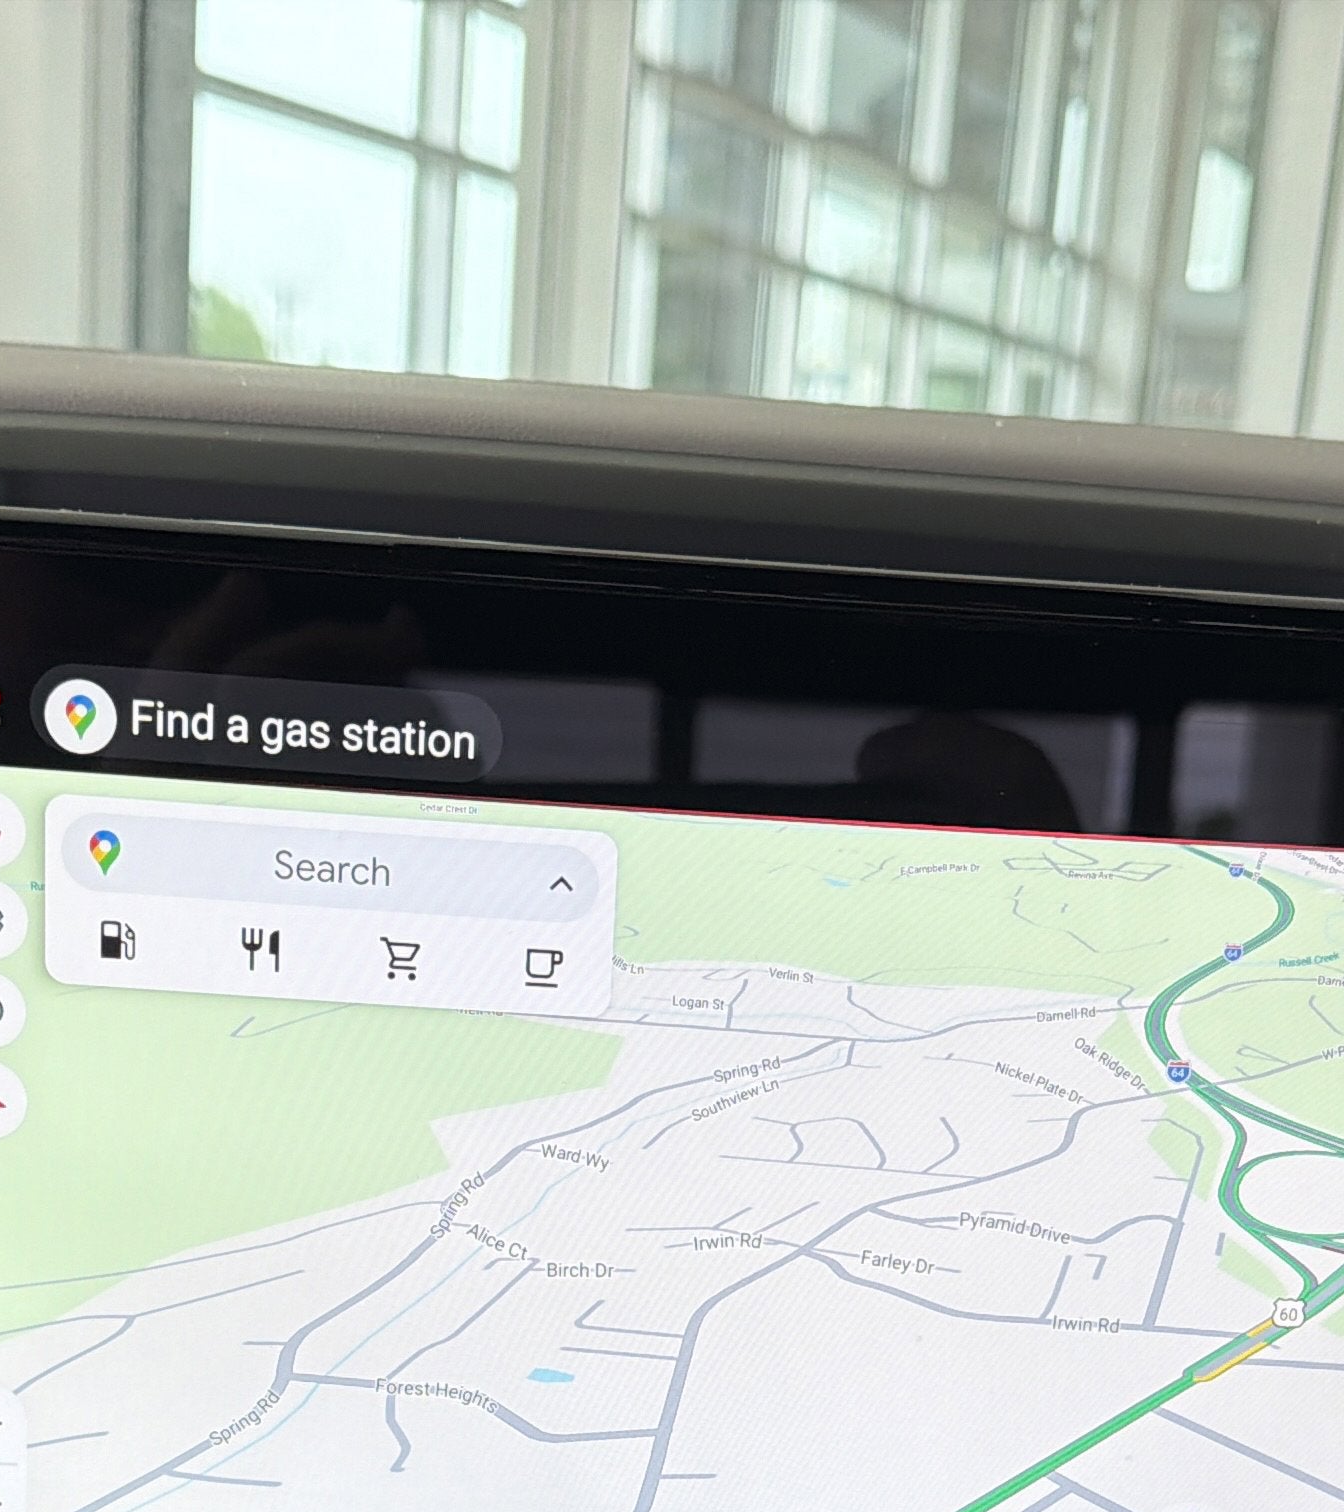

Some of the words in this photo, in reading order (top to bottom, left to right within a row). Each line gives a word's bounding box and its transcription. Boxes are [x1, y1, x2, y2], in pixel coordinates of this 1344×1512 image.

[132, 699, 215, 741] Find
[227, 717, 248, 744] a
[261, 718, 331, 754] gas
[342, 719, 476, 760] station
[274, 850, 390, 886] Search
[908, 864, 948, 876] Campbell
[950, 864, 968, 872] Park
[970, 864, 980, 872] Dr
[1227, 948, 1238, 957] 64
[1278, 958, 1312, 968] Russell
[1314, 952, 1340, 965] Creek
[769, 967, 800, 982] Verlin
[802, 971, 814, 984] St
[672, 996, 709, 1012] Logan
[712, 998, 725, 1011] St
[1036, 1010, 1078, 1022] Darnell
[1080, 1007, 1096, 1018] Rd
[1074, 1038, 1099, 1059] Oak
[1098, 1052, 1132, 1082] Ridge
[1131, 1074, 1146, 1090] Dr
[1322, 1050, 1335, 1060] W
[713, 1062, 760, 1084] Spring
[761, 1056, 781, 1072] Rd
[994, 1061, 1034, 1084] Nickel
[1036, 1076, 1067, 1098] Plate
[1068, 1090, 1084, 1105] Dr
[1171, 1068, 1186, 1079] 64
[691, 1085, 760, 1122] Southview
[760, 1078, 780, 1095] Ln
[542, 1144, 581, 1164] Ward
[585, 1152, 610, 1173] Wy
[430, 1191, 468, 1239] Spring
[461, 1172, 486, 1195] Rd
[960, 1212, 1026, 1236] Pyramid
[1030, 1224, 1071, 1245] Drive
[466, 1224, 506, 1252] Alice
[508, 1242, 528, 1261] Ct
[694, 1234, 734, 1251] Irwin
[740, 1233, 762, 1249] Rd
[546, 1262, 590, 1278] Birch
[596, 1263, 615, 1278] Dr
[860, 1250, 912, 1275] Farley
[915, 1260, 936, 1276] Dr
[1052, 1315, 1092, 1332] Irwin
[1098, 1318, 1120, 1334] Rd
[1280, 1308, 1298, 1322] 60
[376, 1378, 430, 1396] Forest
[436, 1382, 498, 1415] Heights
[208, 1408, 262, 1446] Spring
[257, 1389, 281, 1414] Rd
